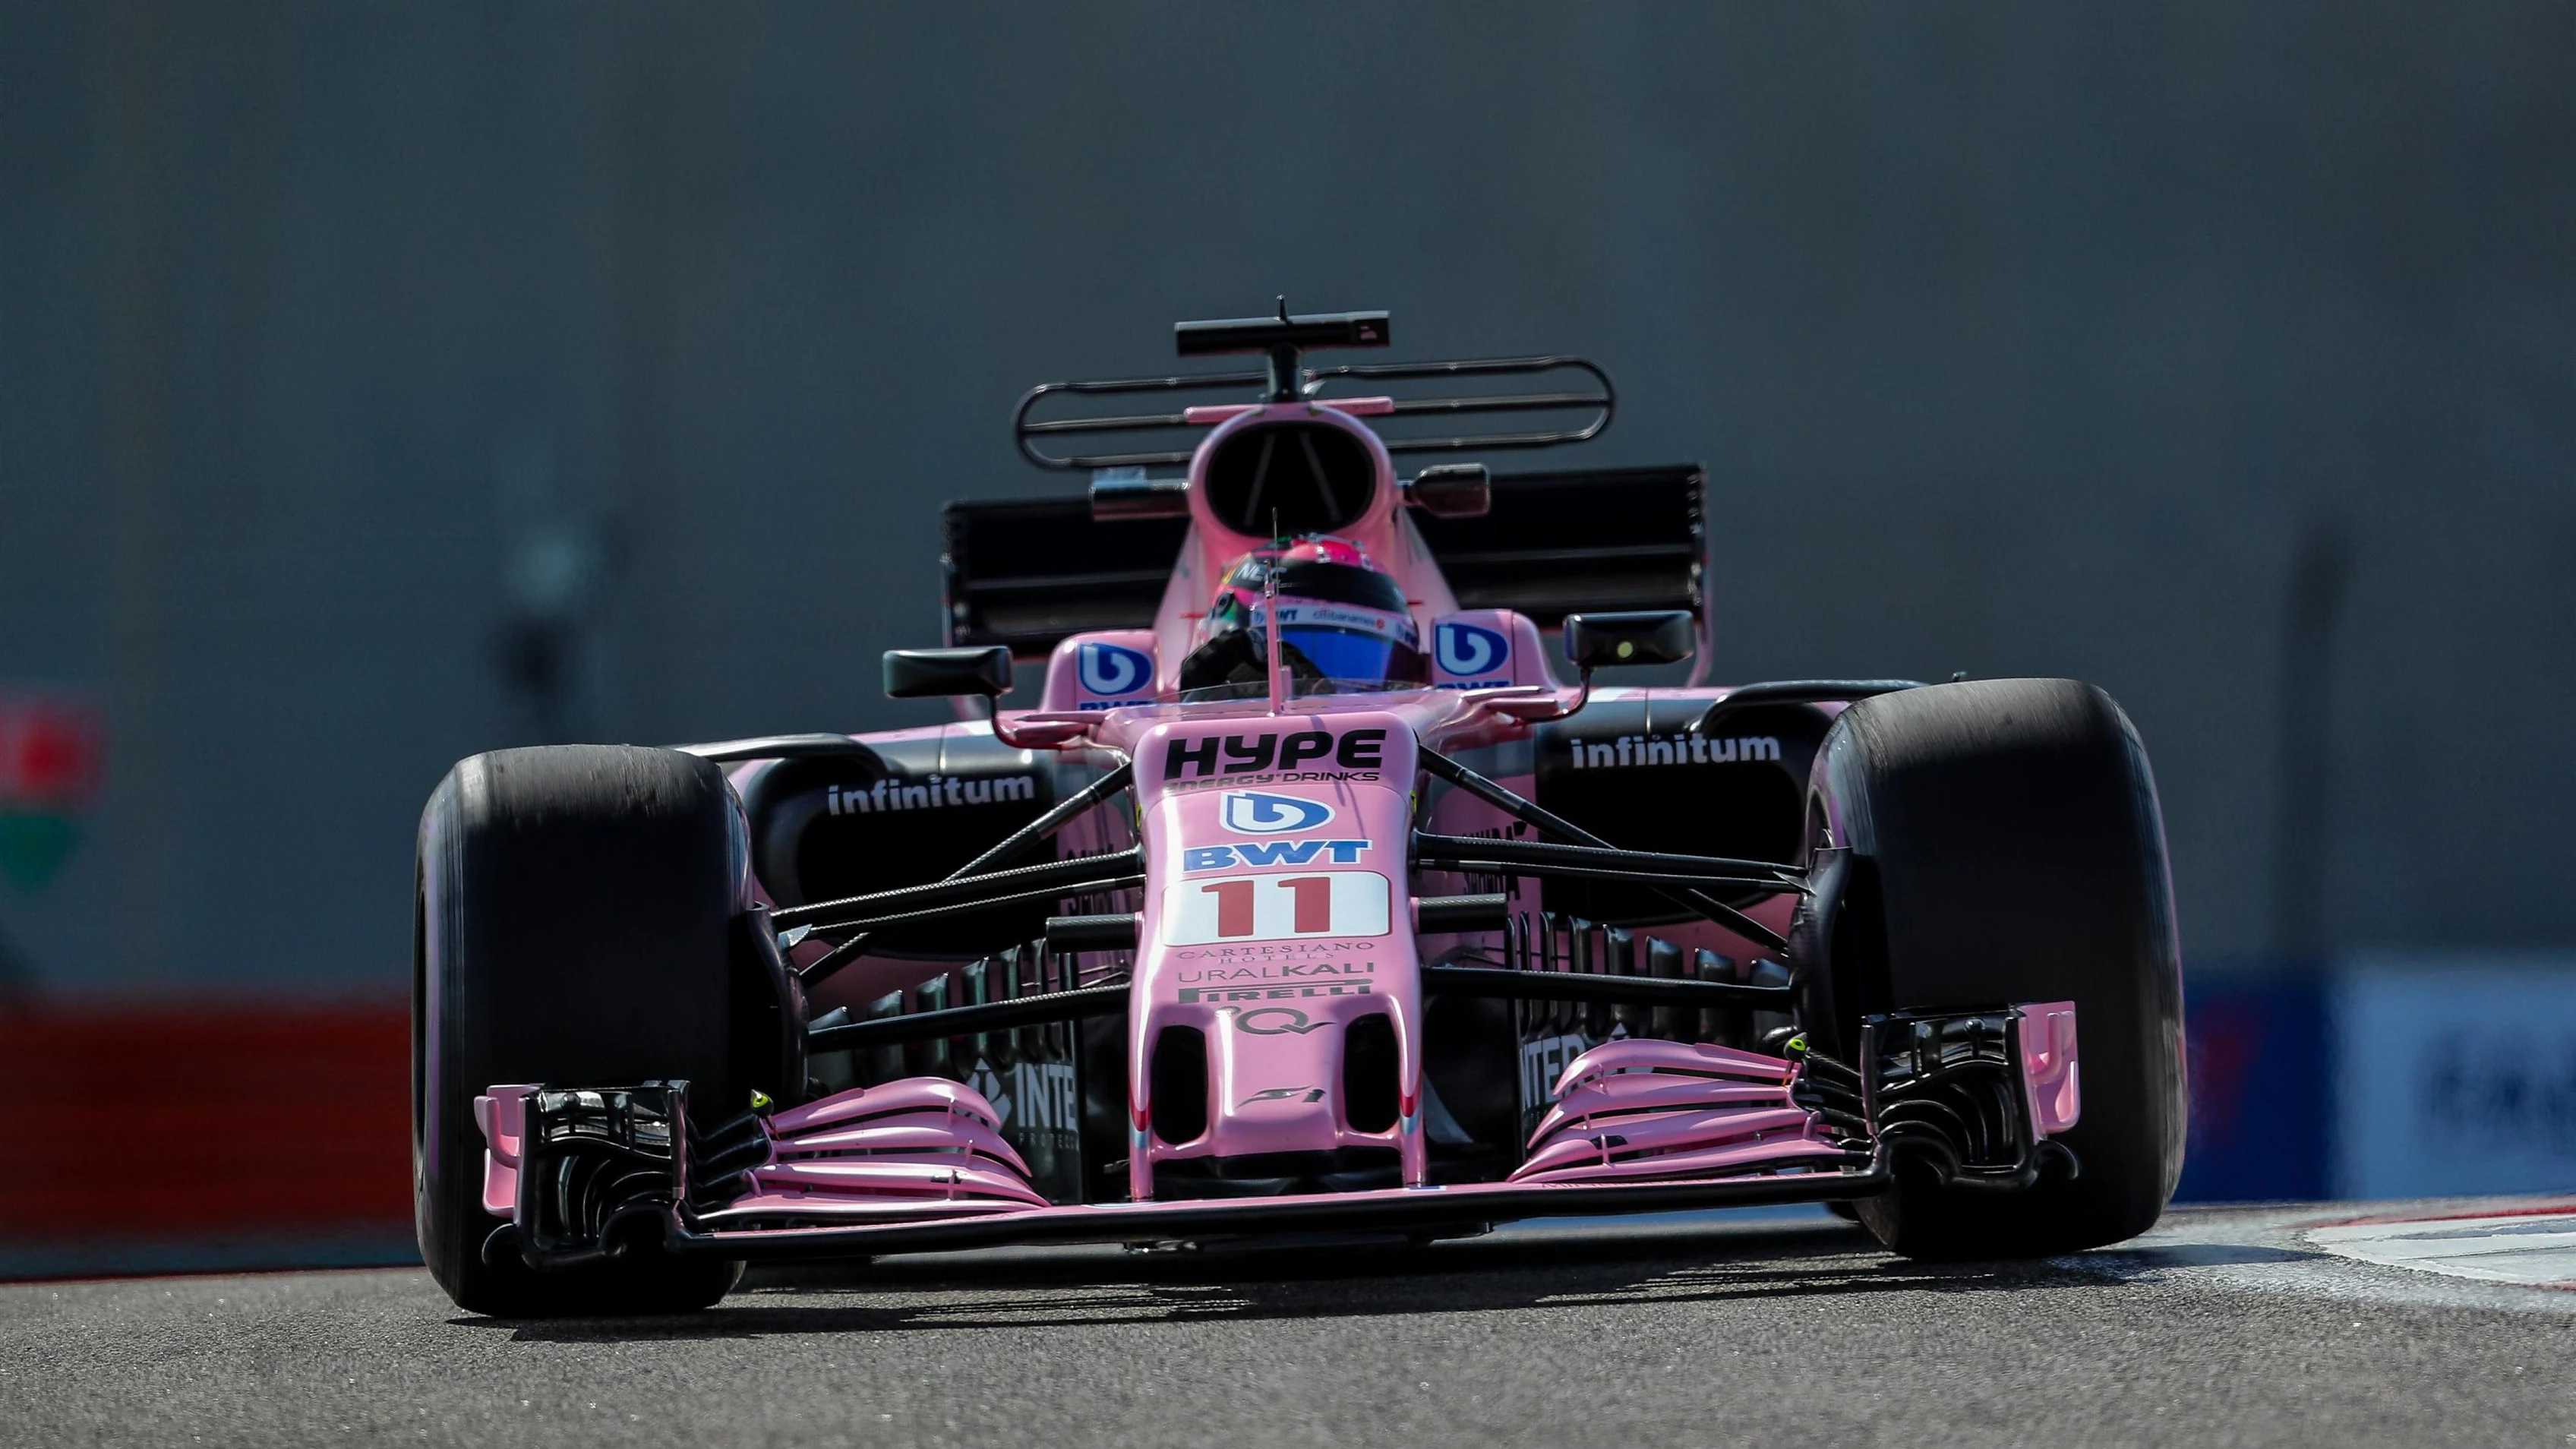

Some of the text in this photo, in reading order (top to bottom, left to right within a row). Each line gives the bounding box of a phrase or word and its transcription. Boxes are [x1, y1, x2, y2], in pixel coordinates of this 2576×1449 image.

[1163, 729, 1387, 781] HYPE
[1571, 732, 1782, 769] infinitum
[1283, 772, 1380, 782] DRINKS
[829, 775, 1035, 816] infinitum
[1183, 840, 1371, 873] BWT
[1201, 876, 1331, 938] 11
[1177, 942, 1376, 960] CARTESIANO
[1220, 953, 1334, 964] HOTELS
[1179, 962, 1375, 983] URALKALI
[1178, 978, 1374, 1004] PIRELLI
